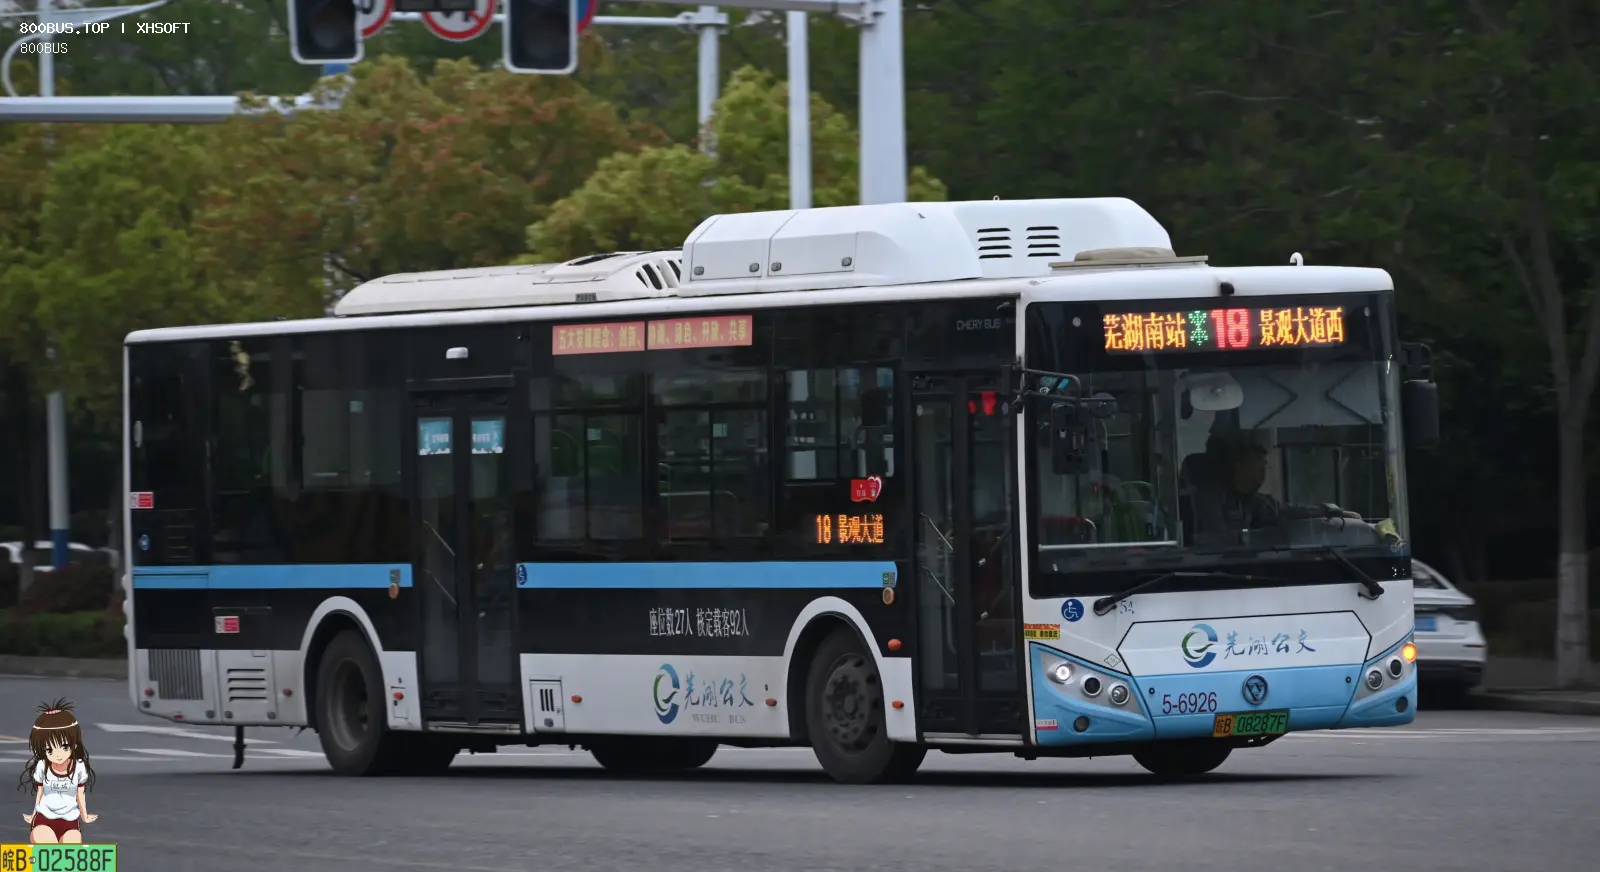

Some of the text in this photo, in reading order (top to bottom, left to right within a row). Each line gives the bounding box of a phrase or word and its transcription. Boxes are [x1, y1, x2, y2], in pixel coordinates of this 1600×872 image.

[984, 317, 1001, 330] BUS
[1102, 306, 1345, 351] 芜湖南站 18 景观大道西
[816, 513, 884, 544] 18 景观大道
[649, 607, 750, 638] 座位数27人 核定载客92人
[1224, 628, 1317, 660] 芜湖公交
[684, 670, 755, 710] 芜湖公交
[1162, 691, 1218, 715] 5-6926
